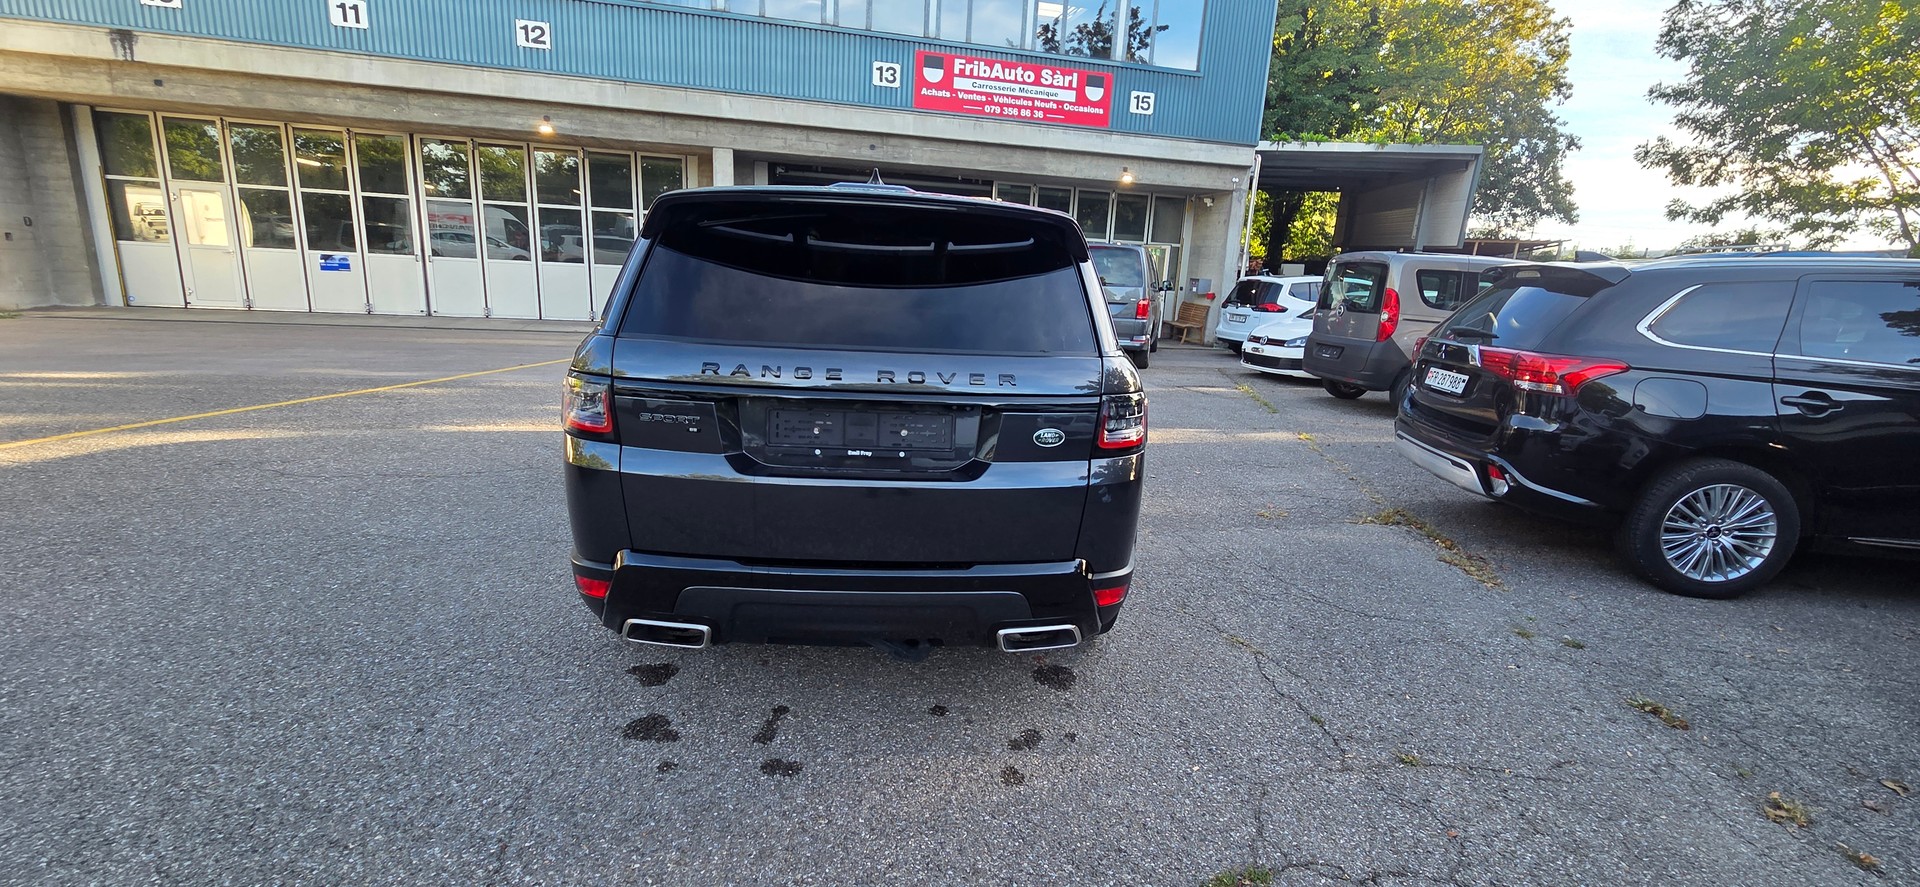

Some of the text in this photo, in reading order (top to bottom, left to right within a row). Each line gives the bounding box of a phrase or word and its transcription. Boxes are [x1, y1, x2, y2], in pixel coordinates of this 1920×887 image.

[335, 2, 361, 24] 11
[519, 24, 547, 46] 12
[875, 65, 897, 84] 13
[953, 58, 1078, 88] FribAuto Sàrl
[971, 81, 1059, 98] Carrosserie Mécanique
[920, 87, 1104, 115] Achats Ventes Véhicules Neufs Occasions
[1133, 94, 1151, 111] 15
[984, 104, 1044, 119] 079 356 86 36
[701, 361, 1017, 387] RANGE ROVER
[639, 412, 701, 425] SPORT
